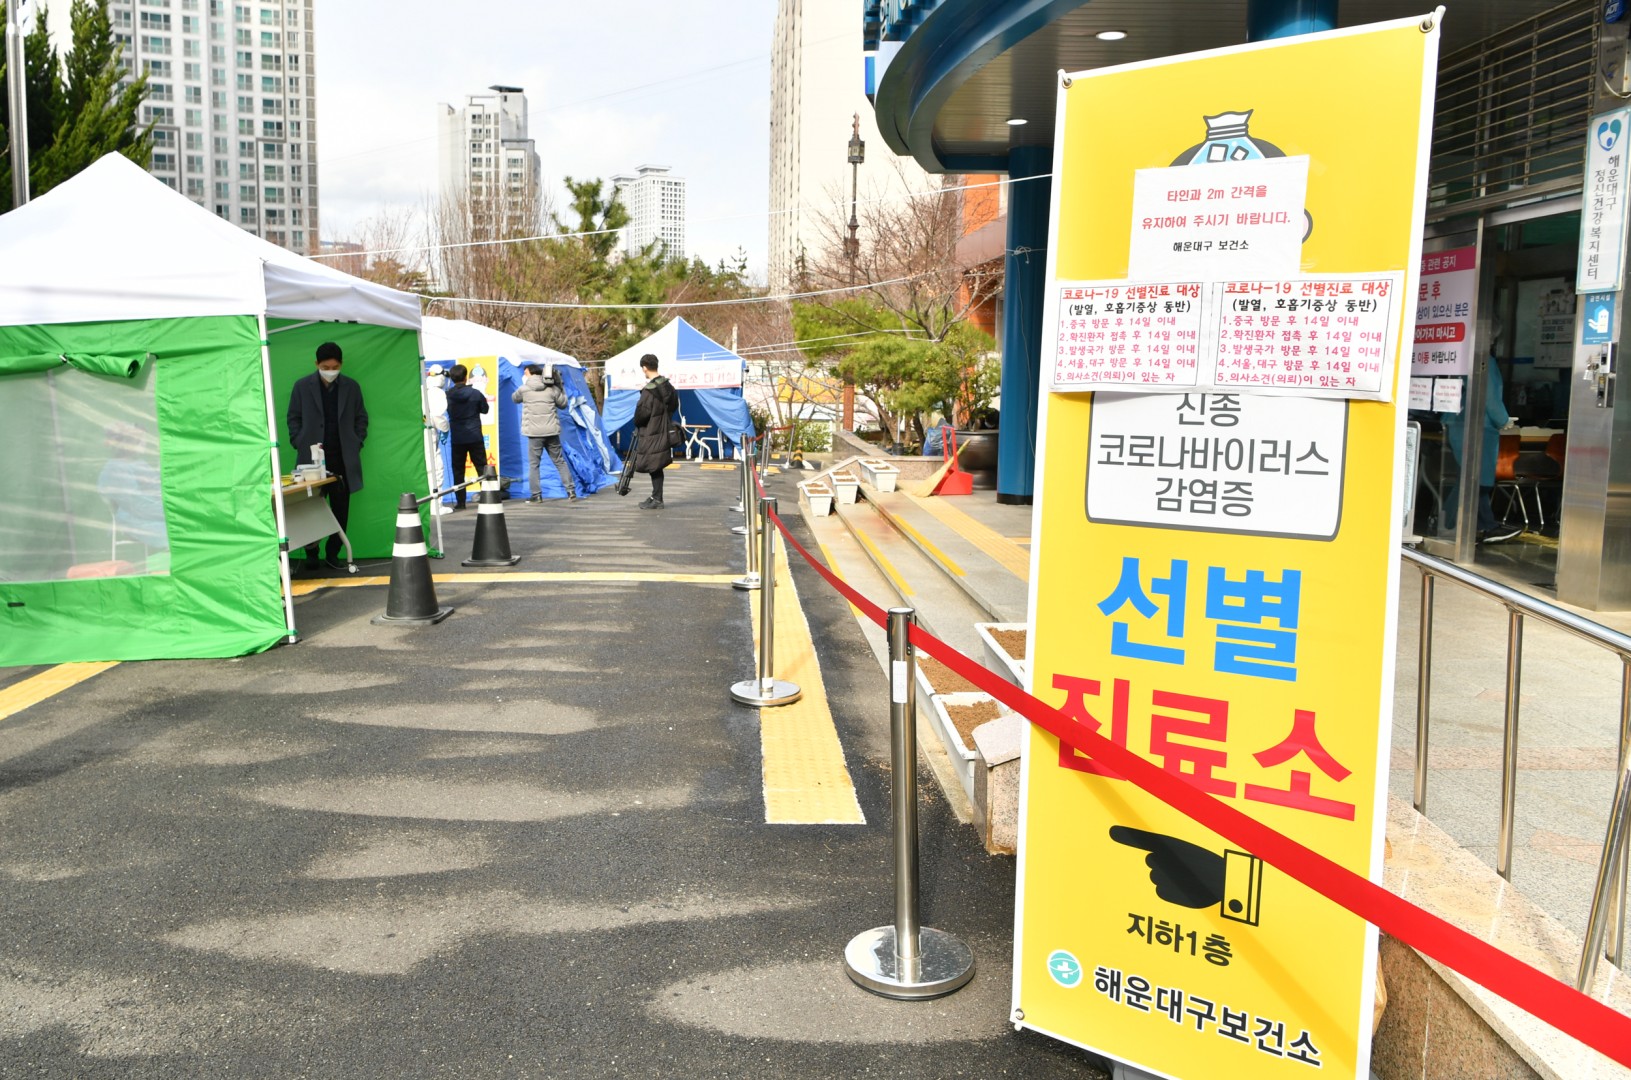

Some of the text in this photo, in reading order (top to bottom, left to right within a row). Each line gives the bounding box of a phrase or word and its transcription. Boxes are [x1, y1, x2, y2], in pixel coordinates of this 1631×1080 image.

[1606, 155, 1620, 210] 해운대구
[1167, 185, 1267, 202] 타인과 2m 간격을
[1142, 212, 1290, 229] 유지하여 주시기 바랍니다.
[1587, 170, 1606, 280] 정신건강복지센터
[1173, 240, 1249, 252] 해운대구 보건소
[1428, 257, 1440, 271] 관련
[1442, 254, 1457, 269] 공지
[1063, 284, 1200, 299] 코로나-19 선별진료 대상
[1225, 282, 1389, 297] 코로나-19 선별진료 대상
[1431, 281, 1441, 300] 후
[1069, 301, 1191, 315] (발열, 호흡기증상 동반)
[1232, 299, 1377, 312] (발열, 호흡기증상 동반)
[1432, 304, 1453, 318] 있으신
[1455, 302, 1469, 317] 분은
[1092, 319, 1109, 328] 방문
[1115, 318, 1123, 326] 후
[1130, 317, 1150, 327] 14일
[1158, 317, 1176, 326] 이내
[1260, 316, 1280, 326] 방문
[1287, 315, 1296, 325] 후
[1305, 316, 1329, 326] 14일
[1337, 317, 1359, 326] 이내
[1111, 331, 1127, 341] 접촉
[1133, 331, 1141, 339] 후
[1149, 331, 1170, 340] 14일
[1177, 331, 1196, 339] 이내
[1282, 331, 1302, 341] 접촉
[1308, 331, 1318, 340] 후
[1327, 332, 1351, 341] 14일
[1360, 332, 1382, 342] 이내
[1109, 345, 1125, 355] 방문
[1131, 345, 1140, 353] 후
[1148, 345, 1169, 354] 14일
[1177, 345, 1195, 353] 이내
[1281, 345, 1300, 356] 방문
[1308, 345, 1318, 355] 후
[1326, 346, 1350, 357] 14일
[1358, 347, 1380, 357] 이내
[1417, 351, 1430, 365] 이동
[1431, 350, 1457, 364] 바랍니다
[1110, 358, 1127, 368] 방문
[1133, 358, 1142, 366] 후
[1149, 359, 1170, 368] 14일
[1177, 359, 1195, 367] 이내
[1284, 361, 1303, 370] 방문
[1310, 361, 1320, 370] 후
[1327, 361, 1350, 372] 14일
[1358, 362, 1379, 372] 이내
[1142, 372, 1159, 382] 있는
[1166, 373, 1175, 381] 자
[1320, 375, 1339, 387] 있는
[1346, 377, 1356, 386] 자
[1176, 392, 1241, 427] 신종
[1097, 433, 1329, 476] 코로나바이러스
[1155, 477, 1254, 516] 감염증
[1096, 556, 1301, 682] 선별
[1052, 673, 1355, 821] 진료소
[1127, 912, 1233, 967] 지하1층
[1094, 965, 1322, 1067] 해운대구보건소
